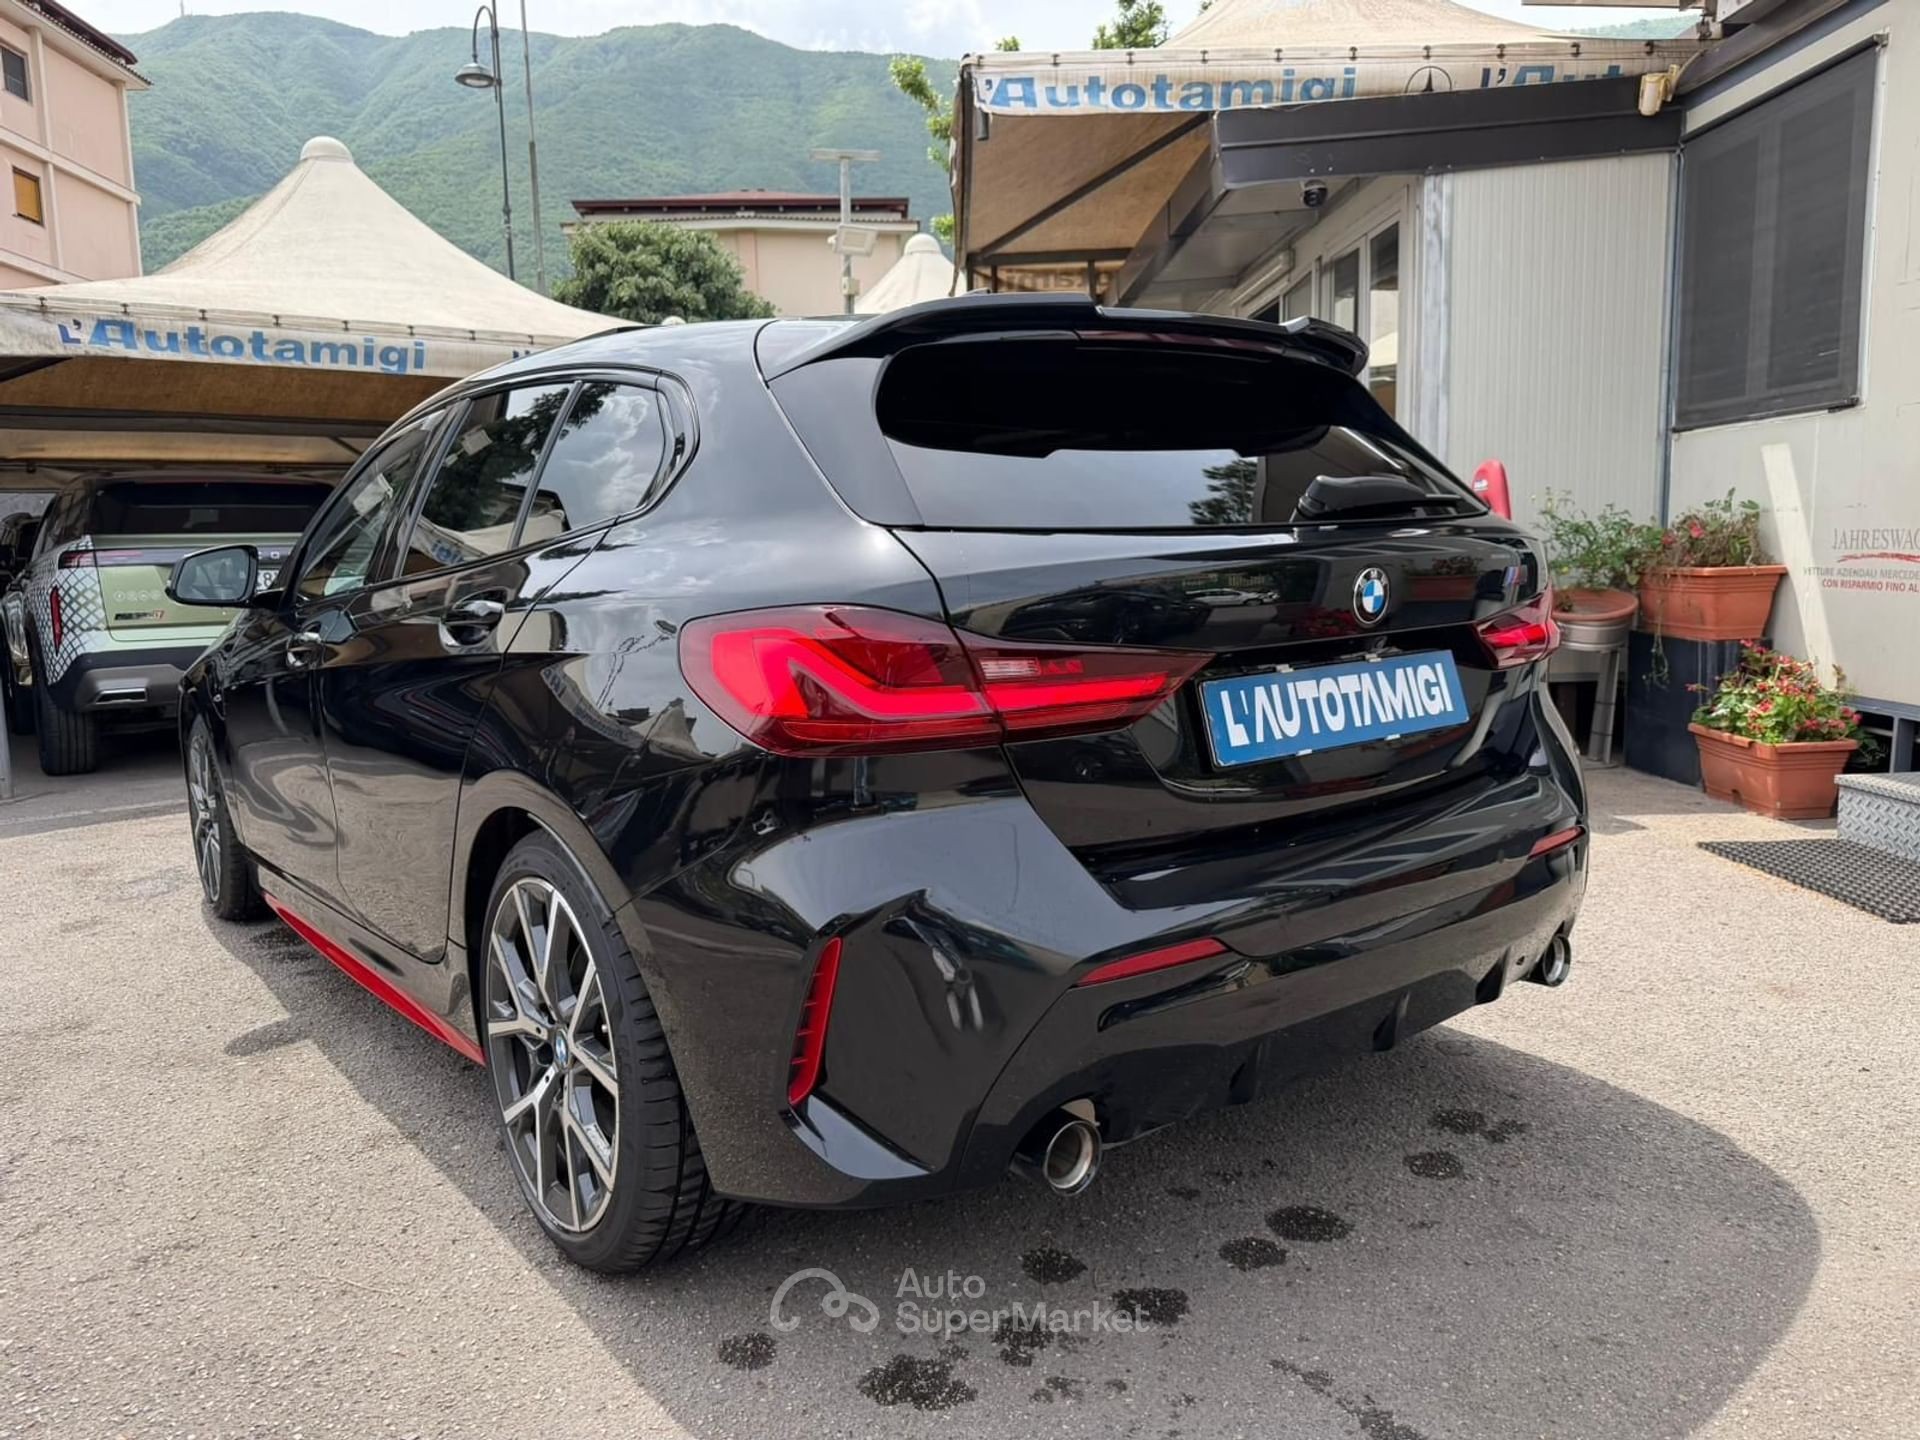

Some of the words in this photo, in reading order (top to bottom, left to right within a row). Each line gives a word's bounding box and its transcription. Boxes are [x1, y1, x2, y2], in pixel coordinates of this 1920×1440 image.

[57, 318, 425, 374] L'Autotamigi
[1822, 578, 1838, 588] CON
[1840, 579, 1883, 591] RISPARMIO
[1885, 582, 1905, 592] FINO
[1220, 662, 1453, 747] L'AUTOTAMIGI
